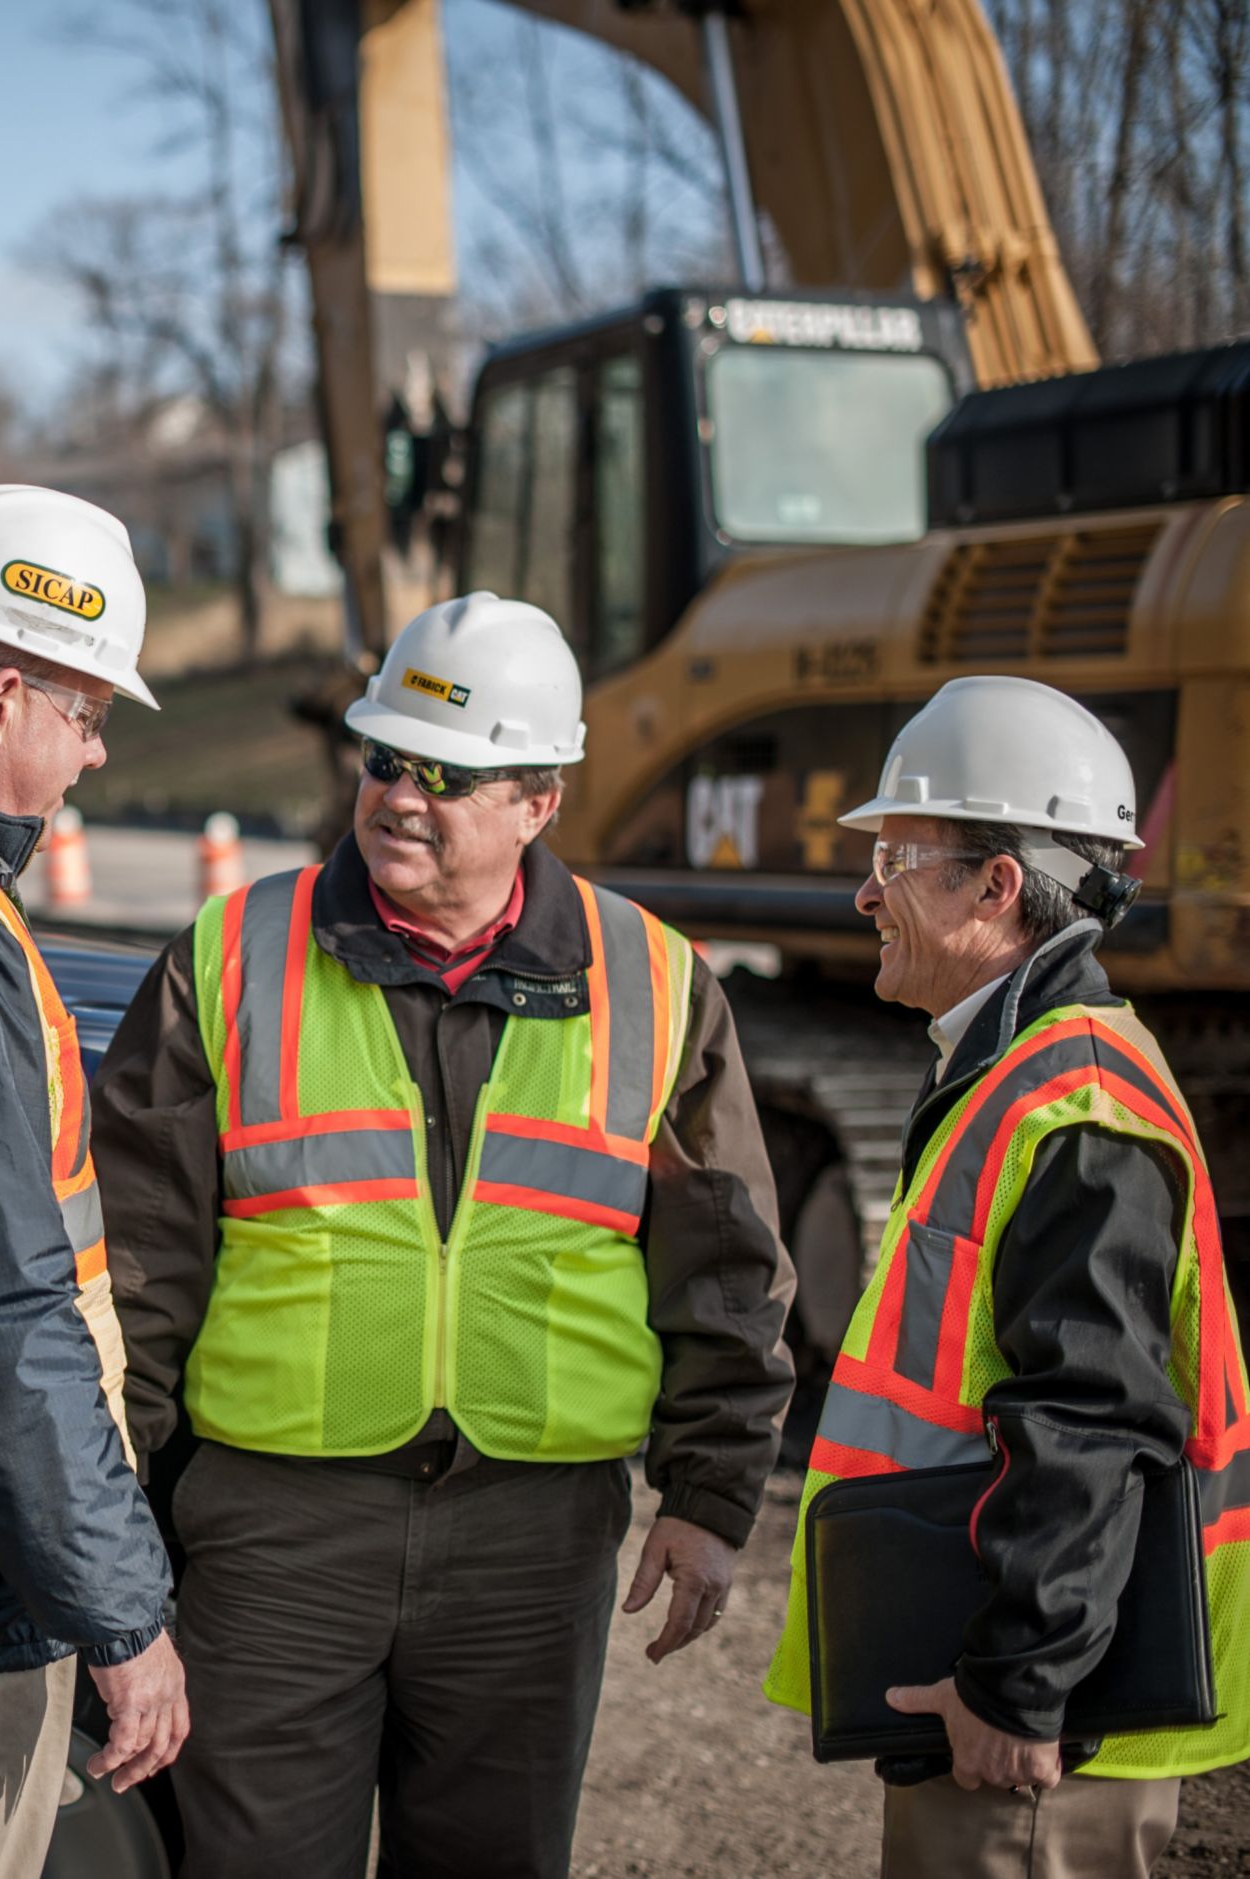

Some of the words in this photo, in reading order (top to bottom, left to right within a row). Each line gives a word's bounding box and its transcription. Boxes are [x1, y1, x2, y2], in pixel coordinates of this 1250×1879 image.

[15, 569, 94, 611] SICAP
[451, 688, 468, 703] CAT
[687, 775, 764, 870] CAT
